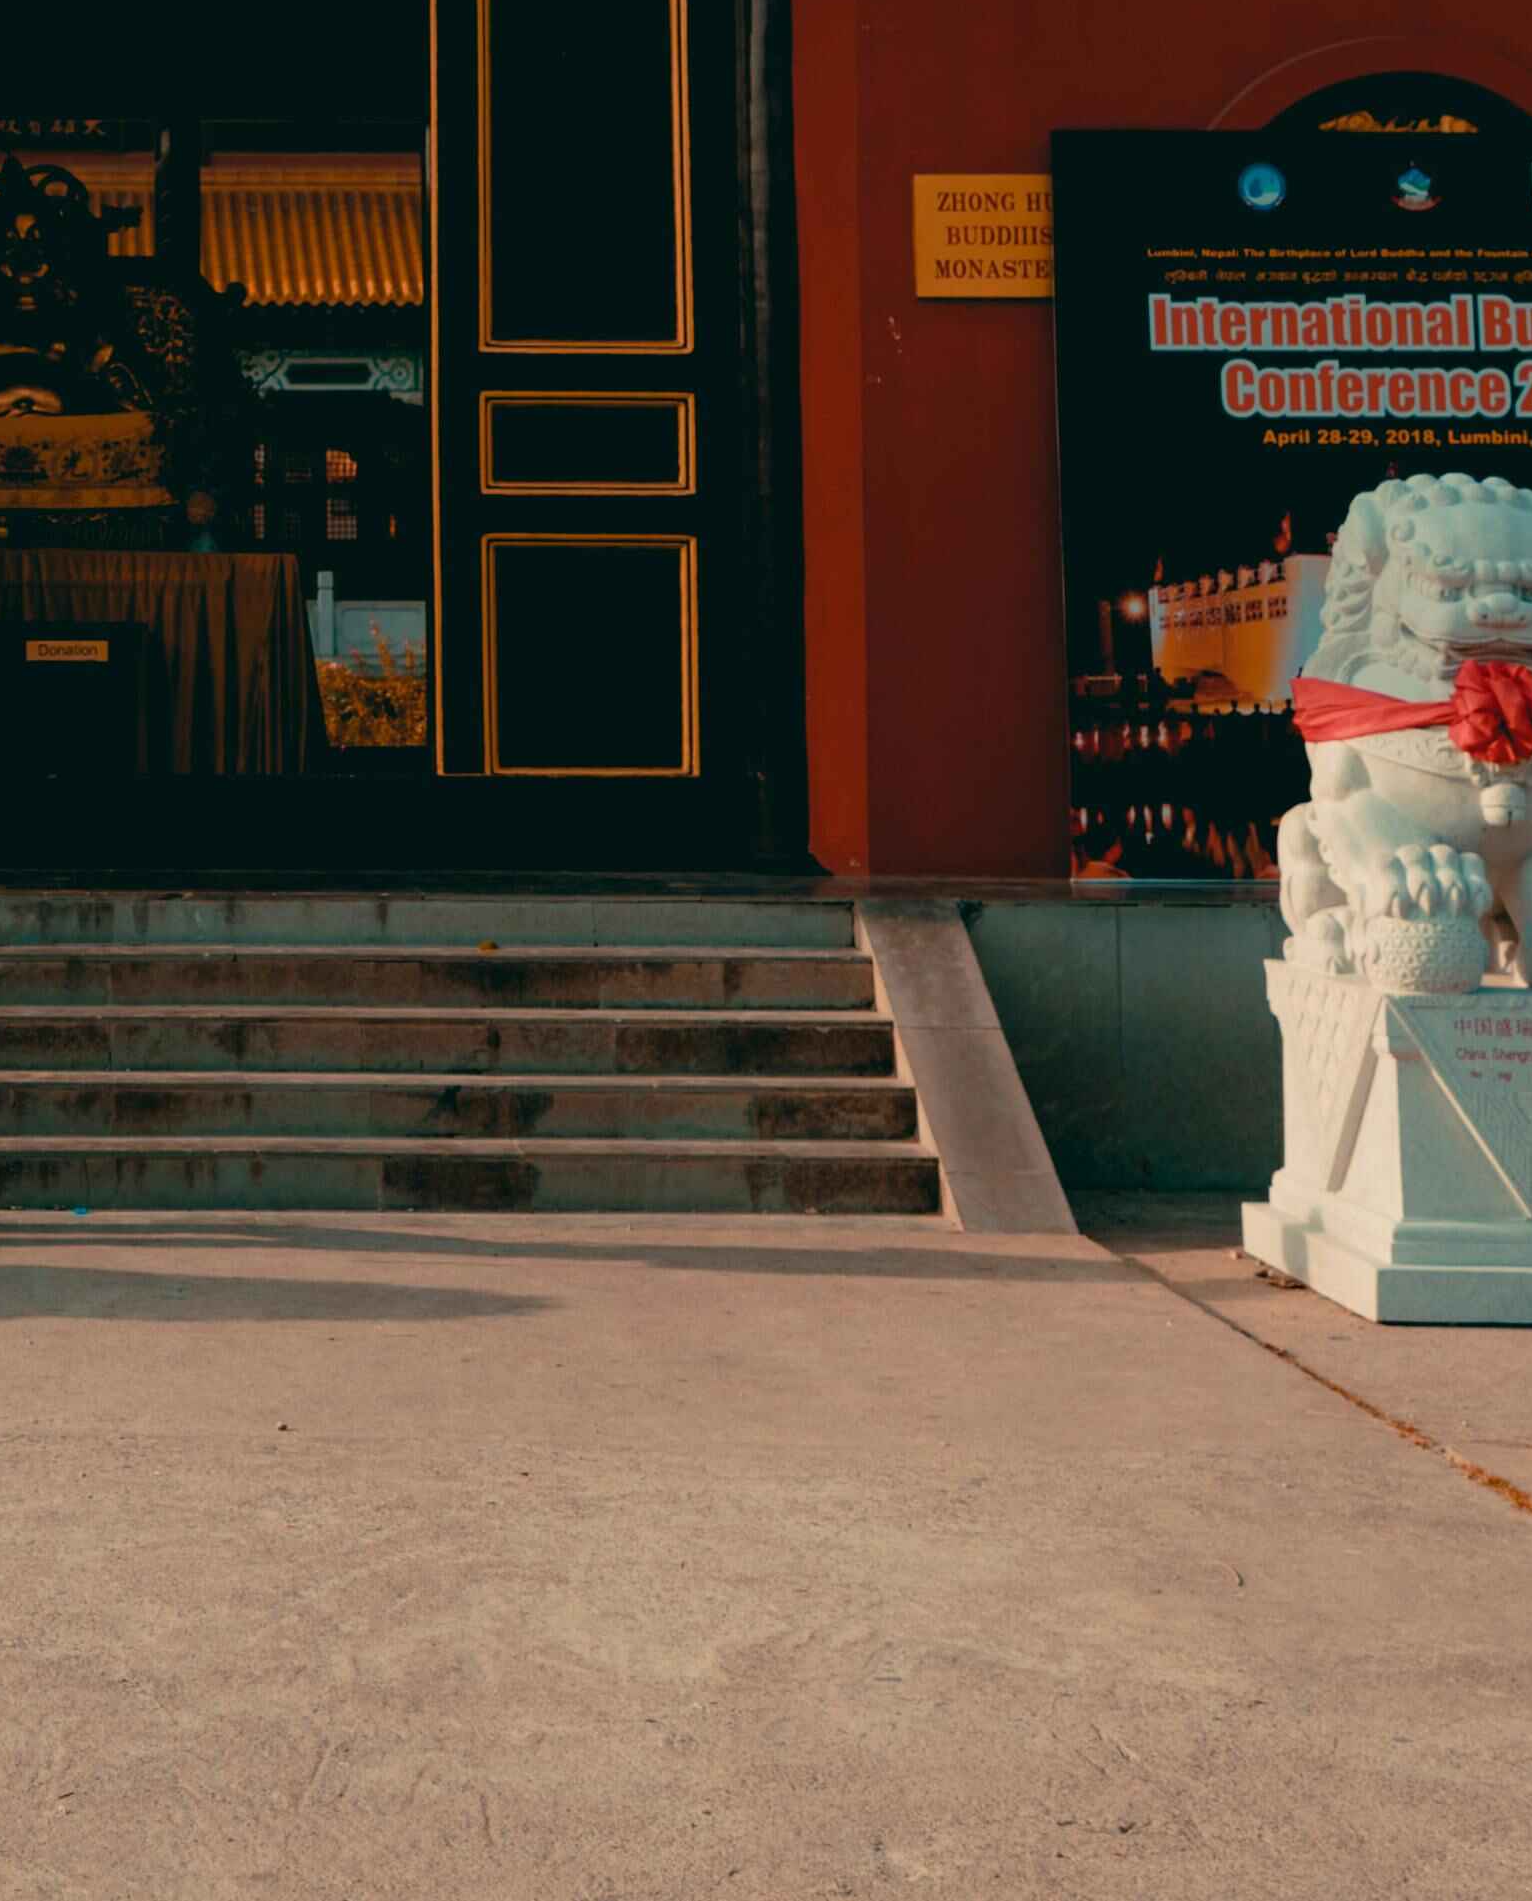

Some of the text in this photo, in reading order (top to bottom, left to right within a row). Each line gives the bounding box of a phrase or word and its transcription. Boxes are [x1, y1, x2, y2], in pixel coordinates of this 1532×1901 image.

[936, 191, 1016, 212] ZHONG
[1244, 248, 1265, 258] The
[1335, 248, 1347, 258] of
[1350, 248, 1377, 258] Lord
[1429, 248, 1451, 258] and
[1455, 248, 1473, 258] the
[934, 259, 1051, 279] MONASTE
[1149, 295, 1474, 350] International
[1221, 359, 1511, 417] Conference
[1263, 429, 1310, 447] April
[1317, 429, 1379, 446] 28-29,
[1386, 430, 1441, 446] 2018,
[37, 643, 99, 657] Donation
